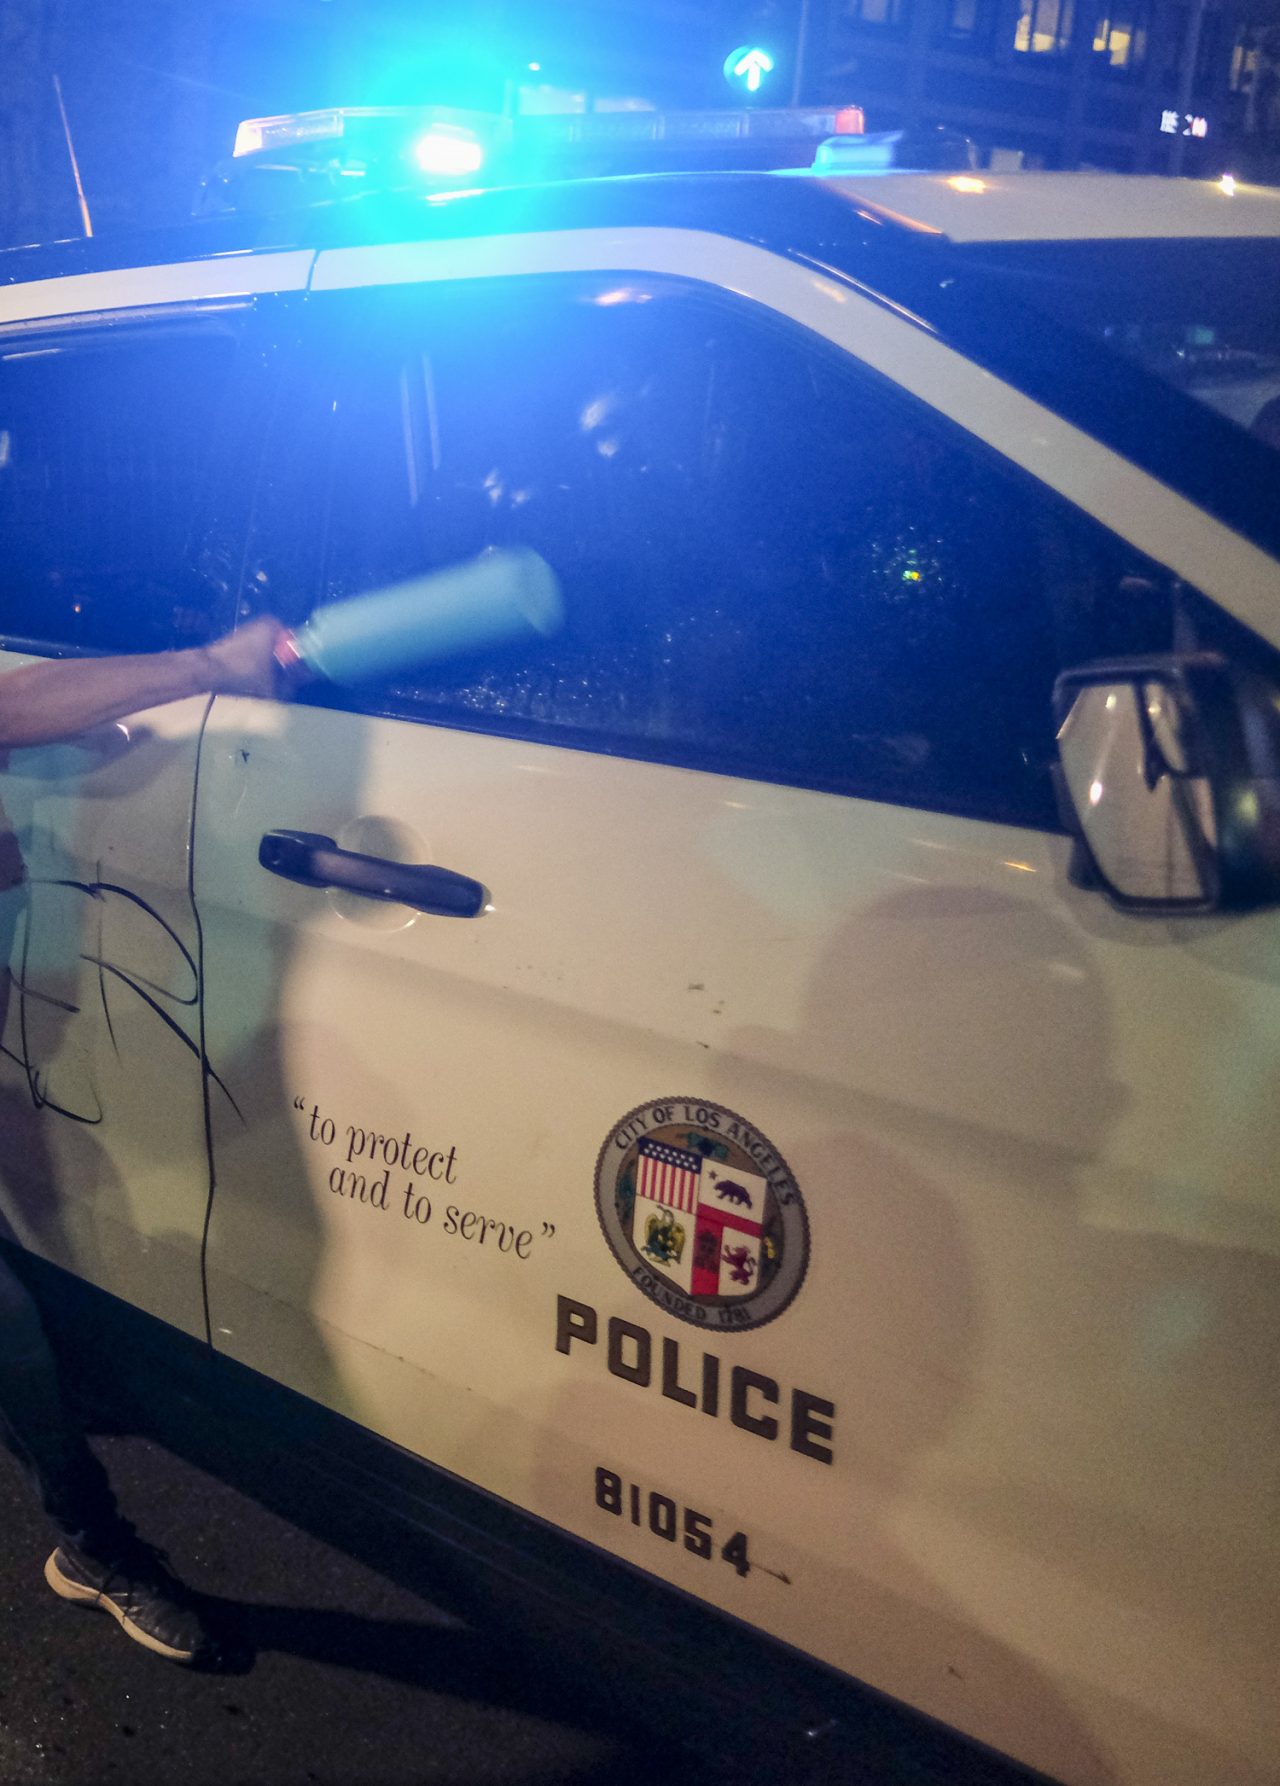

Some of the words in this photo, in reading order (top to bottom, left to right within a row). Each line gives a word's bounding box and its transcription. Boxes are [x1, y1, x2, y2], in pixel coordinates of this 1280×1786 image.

[328, 1166, 390, 1211] and
[403, 1182, 432, 1224] to
[346, 1124, 457, 1185] protect
[614, 1115, 648, 1151] CITY
[652, 1106, 675, 1124] OF
[685, 1105, 721, 1129] LOS
[726, 1122, 796, 1206] ANGELES
[631, 1266, 707, 1320] FOUNDED
[555, 1294, 836, 1466] POLICE
[595, 1466, 751, 1578] 81054
